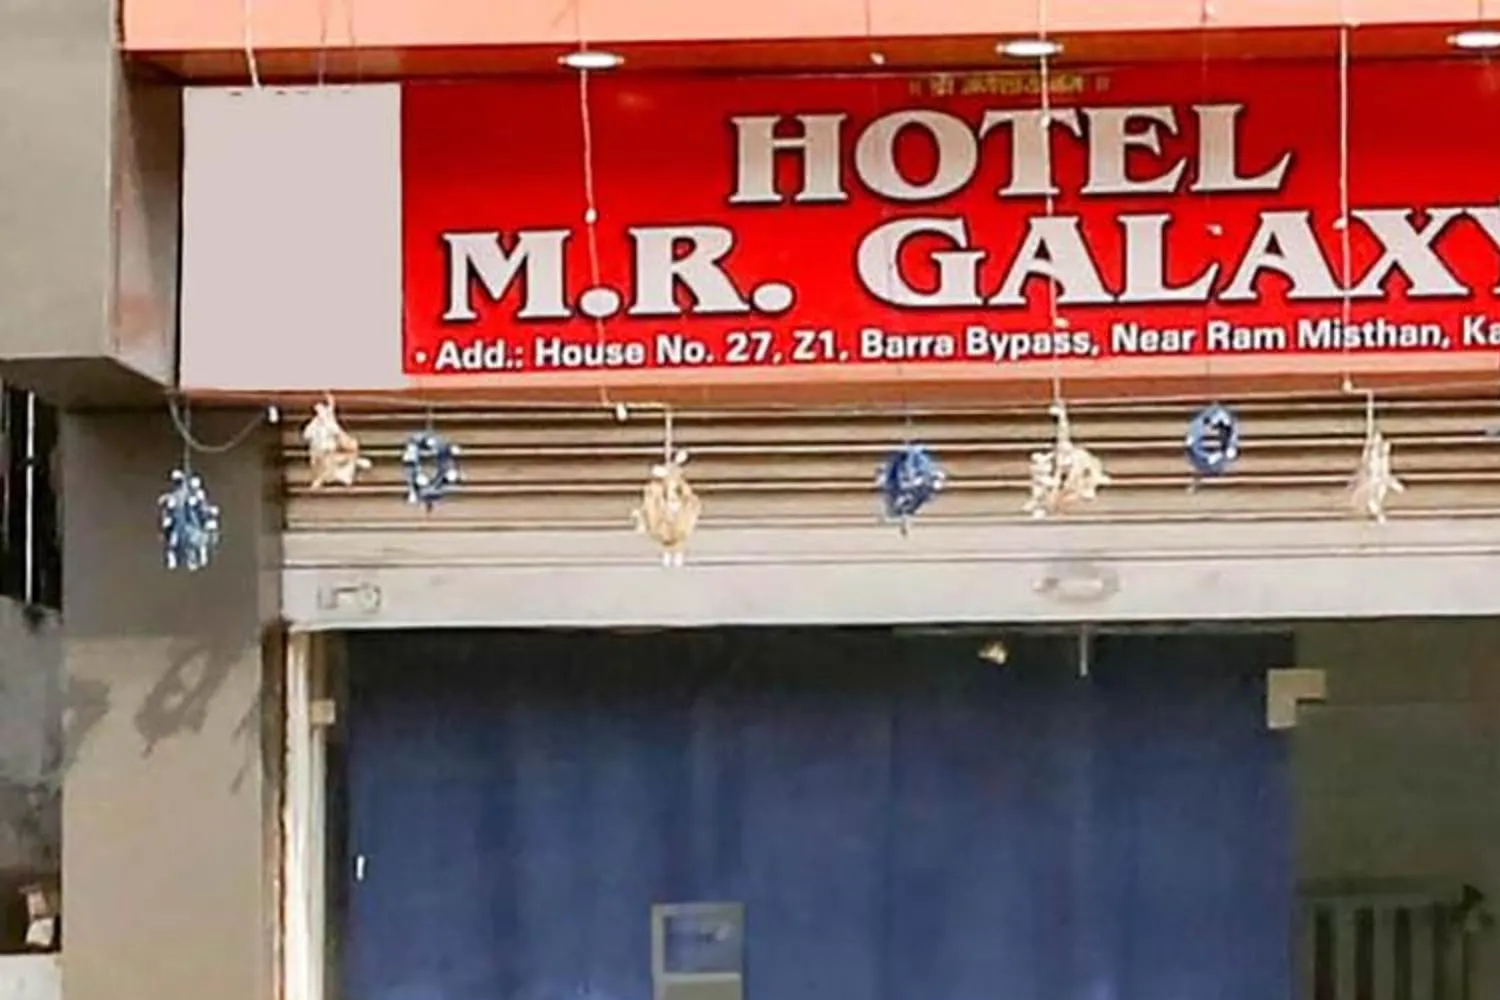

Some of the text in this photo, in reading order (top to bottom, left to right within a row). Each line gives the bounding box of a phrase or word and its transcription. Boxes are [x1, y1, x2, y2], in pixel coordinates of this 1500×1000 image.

[730, 102, 1291, 206] HOTEL
[443, 225, 794, 320] M.R.
[435, 339, 524, 369] Add.:
[535, 336, 644, 367] House
[656, 333, 714, 364] No.
[726, 331, 782, 363] 27,
[861, 328, 955, 358] Barra
[966, 325, 1099, 361] Bypass,
[1112, 322, 1197, 353] Near
[1206, 321, 1286, 350] Ram
[1298, 317, 1451, 350] Misthan,
